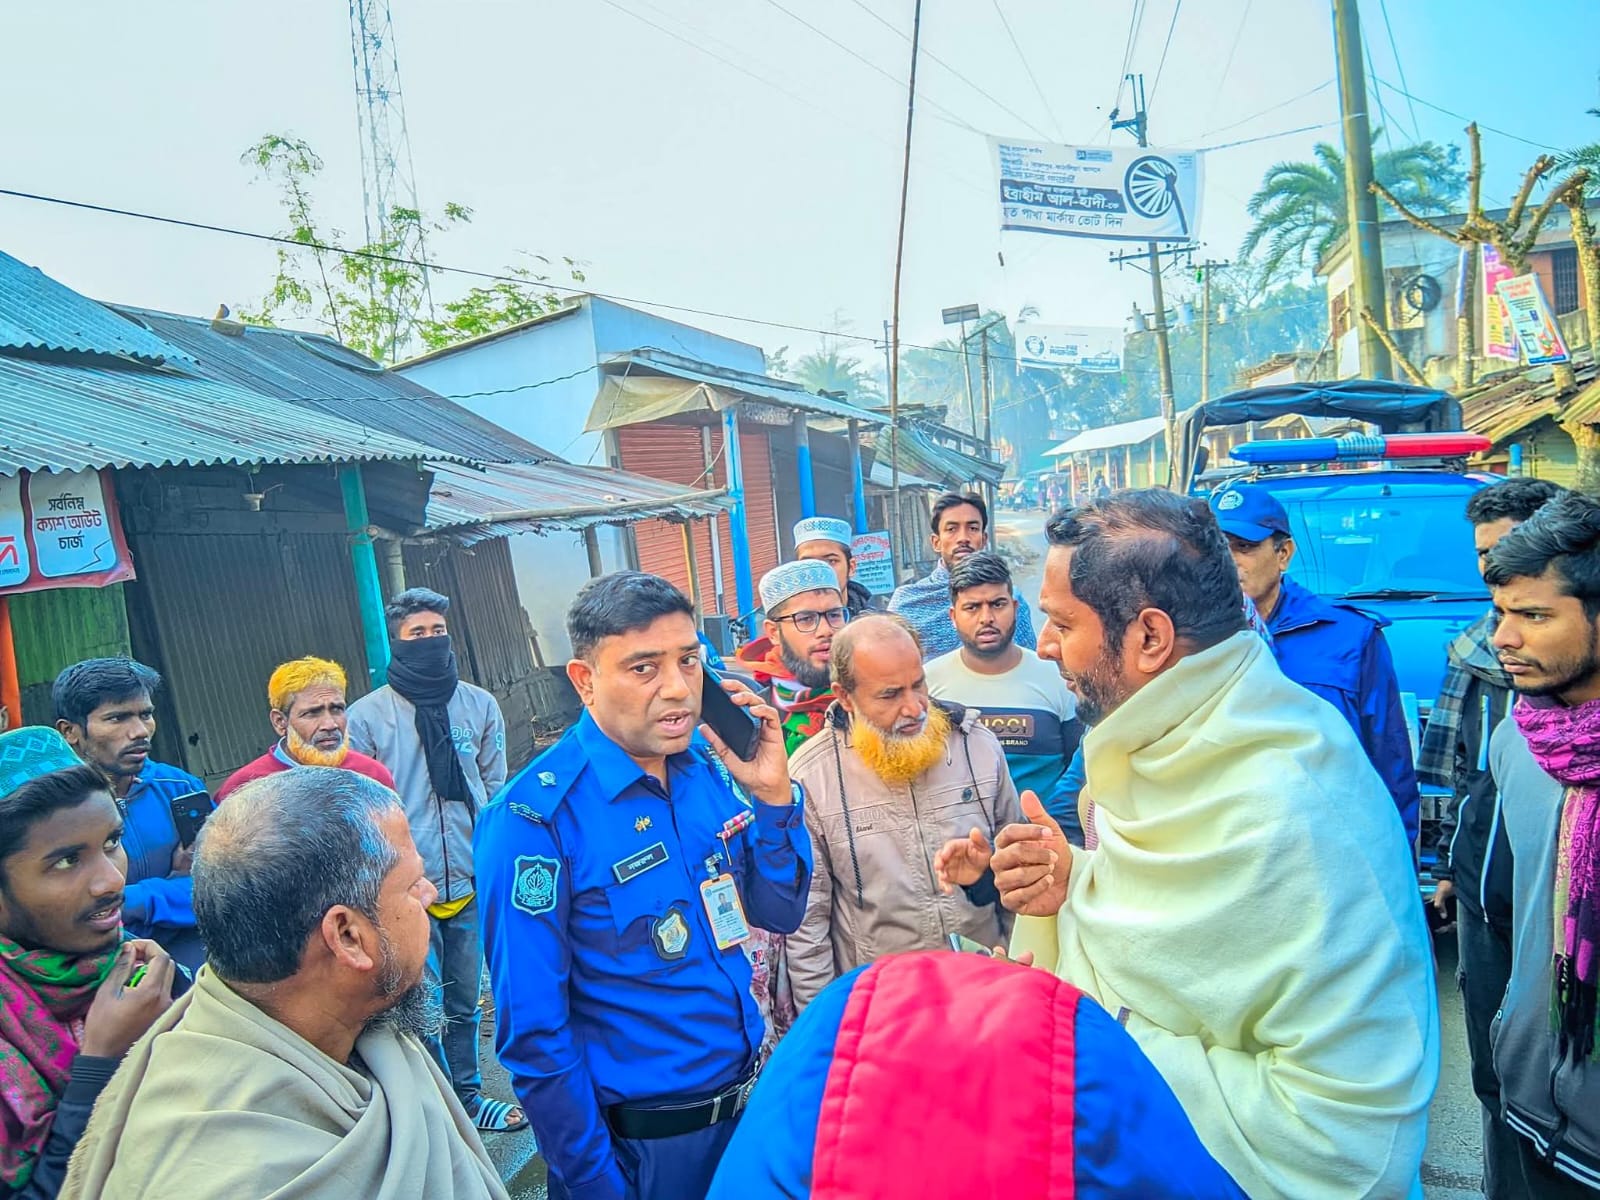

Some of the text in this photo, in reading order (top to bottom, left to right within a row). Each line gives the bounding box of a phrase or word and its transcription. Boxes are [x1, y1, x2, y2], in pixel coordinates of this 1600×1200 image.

[1078, 214, 1102, 226] ভোট
[1105, 213, 1123, 228] দিন
[48, 493, 85, 511] সর্বনিম্ন
[36, 510, 102, 532] ক্যাশ আউট
[58, 530, 85, 550] চার্জ
